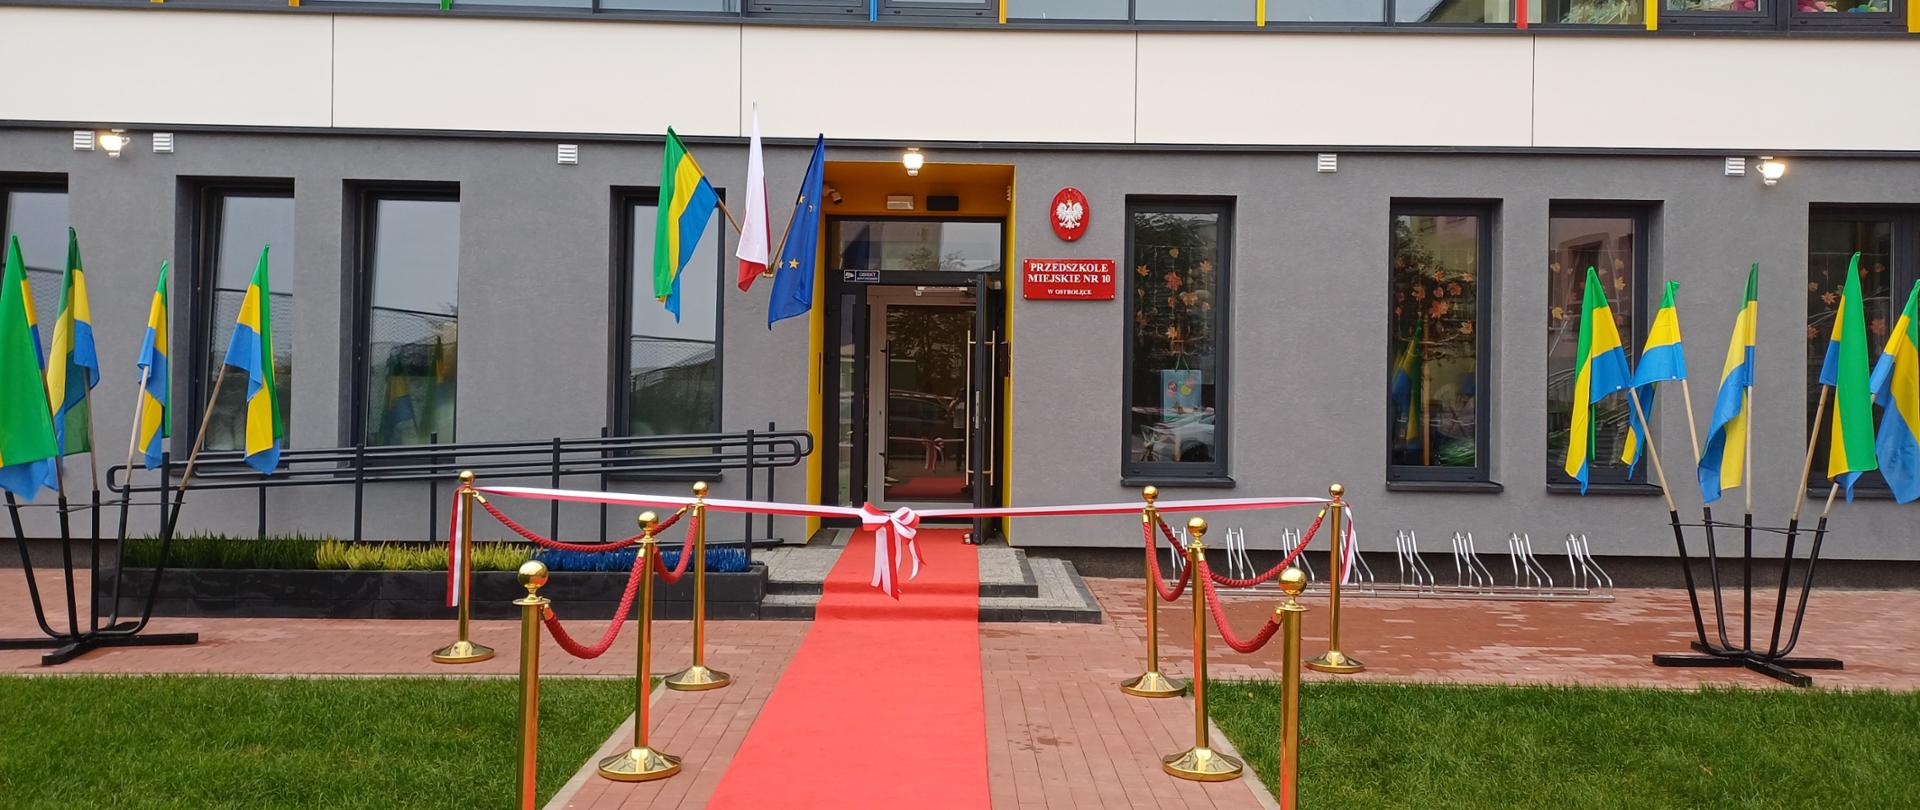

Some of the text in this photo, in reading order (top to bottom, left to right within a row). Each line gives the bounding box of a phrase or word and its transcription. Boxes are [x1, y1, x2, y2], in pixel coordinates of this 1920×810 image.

[1030, 263, 1109, 273] PRZEDSZKOLE
[1028, 273, 1111, 283] MIEJSKIE NR 10
